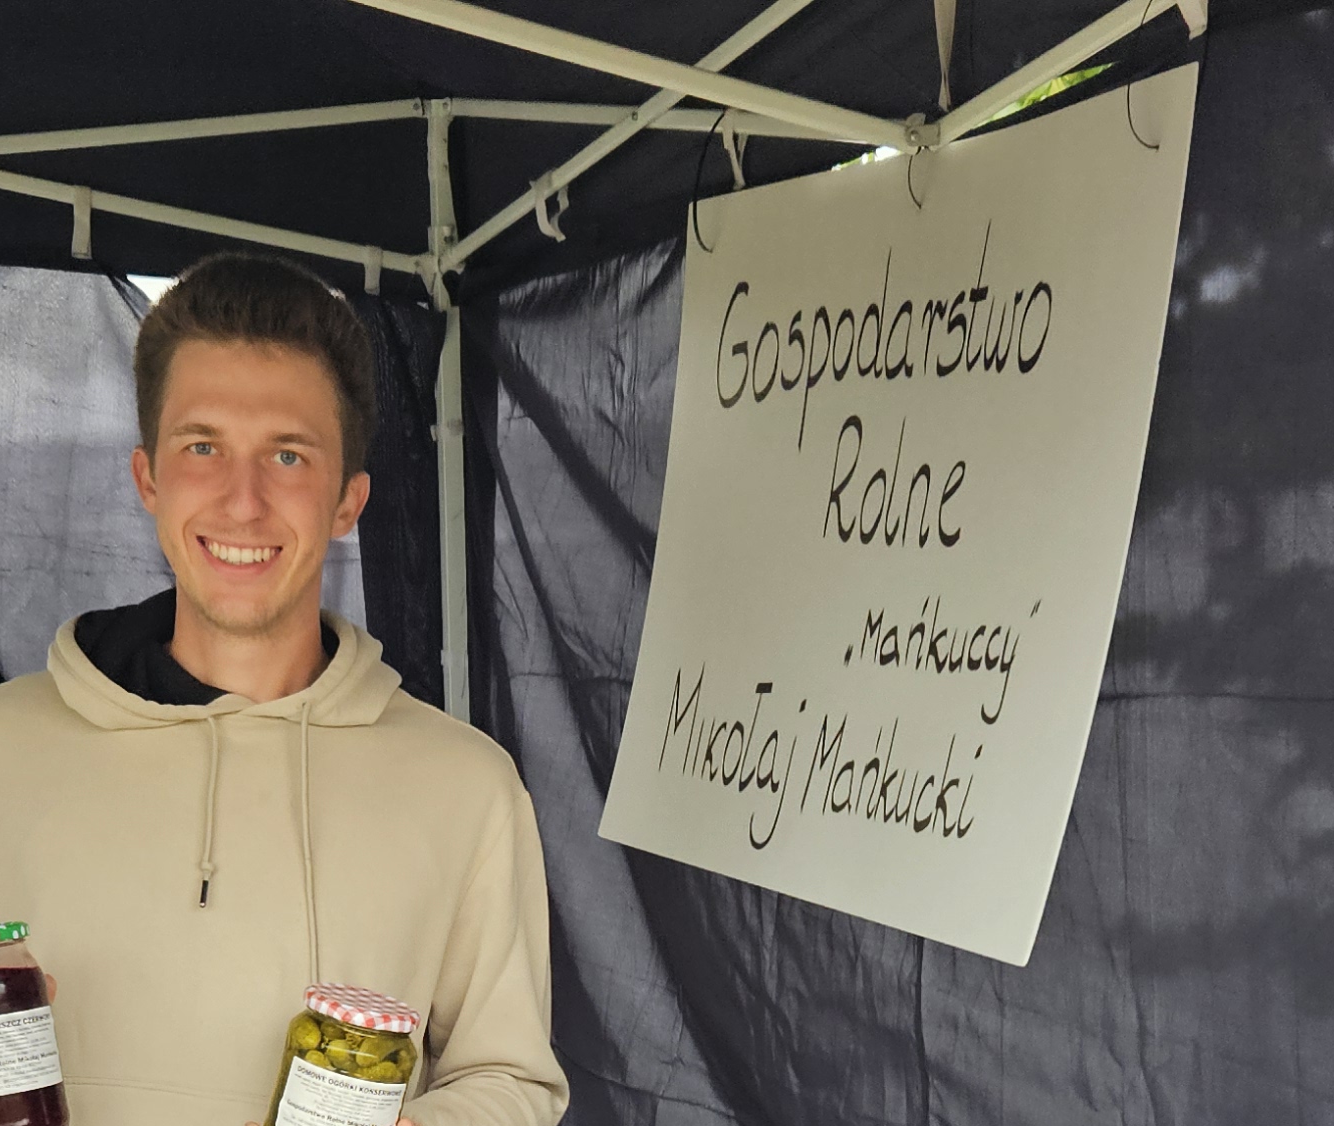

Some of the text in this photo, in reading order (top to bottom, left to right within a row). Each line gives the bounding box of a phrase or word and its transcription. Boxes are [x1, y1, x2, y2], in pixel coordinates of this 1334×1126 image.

[715, 219, 1053, 452] Gospodarstwo
[822, 415, 968, 548] Rolne
[658, 667, 983, 850] Mikołaj Mańkucki
[296, 1064, 327, 1084] DOMOWE
